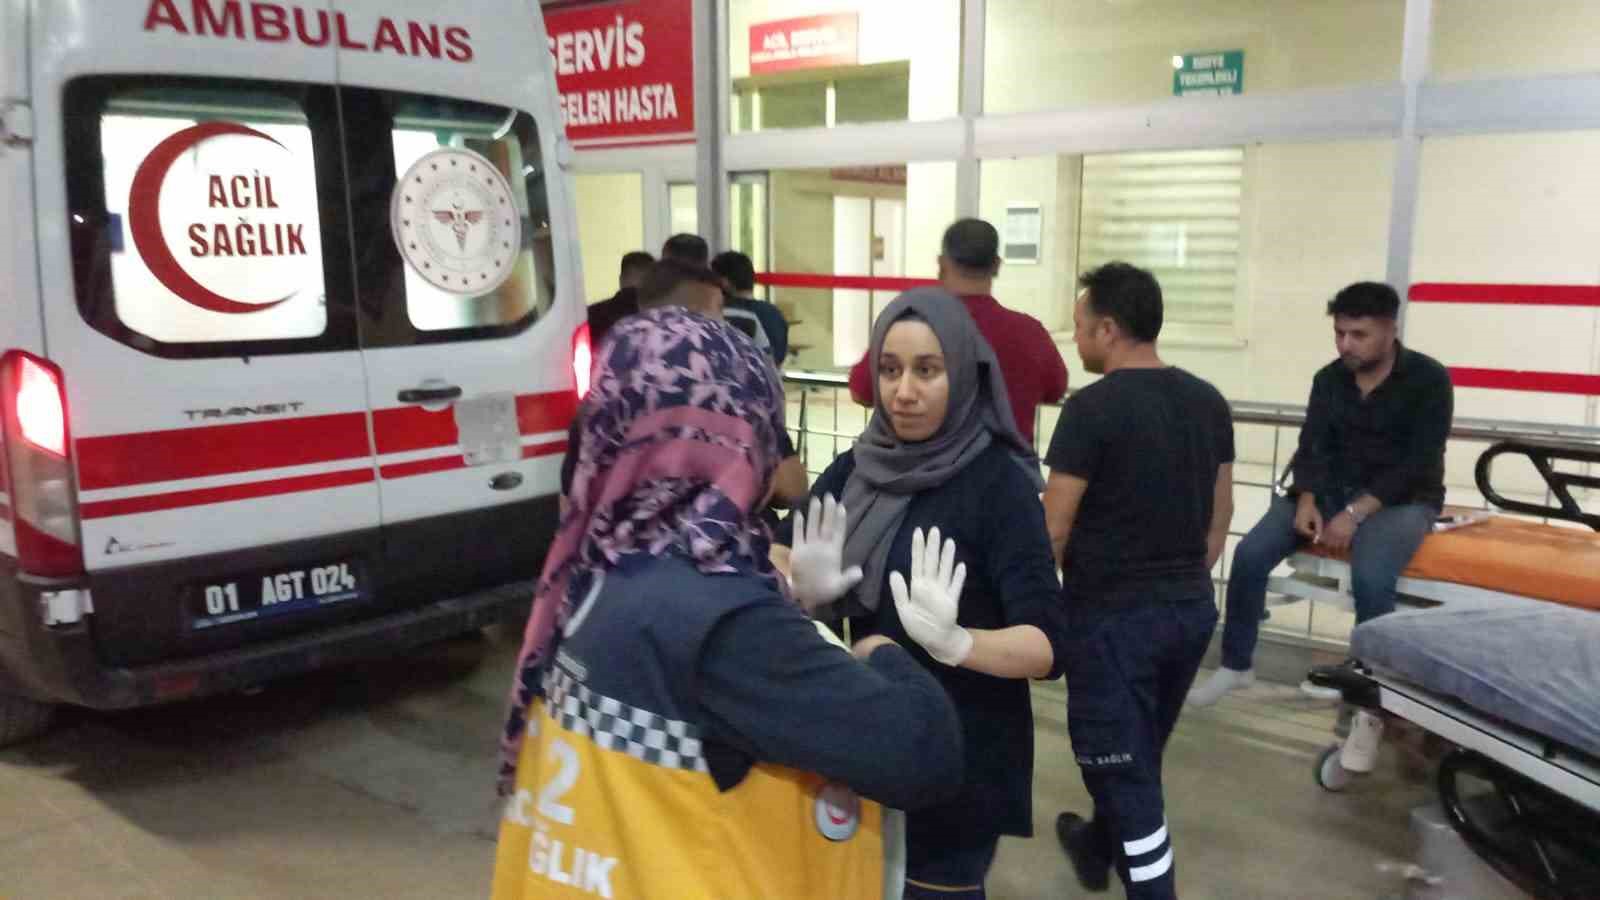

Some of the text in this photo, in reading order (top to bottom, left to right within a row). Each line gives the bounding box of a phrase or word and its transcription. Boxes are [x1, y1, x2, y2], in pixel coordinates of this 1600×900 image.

[142, 0, 475, 63] AMBULANS
[614, 82, 679, 123] HASTA
[208, 168, 279, 209] ACİL
[187, 215, 307, 258] SAĞLIK
[182, 401, 304, 421] TRANSIT
[205, 563, 357, 615] 01 AGT 024
